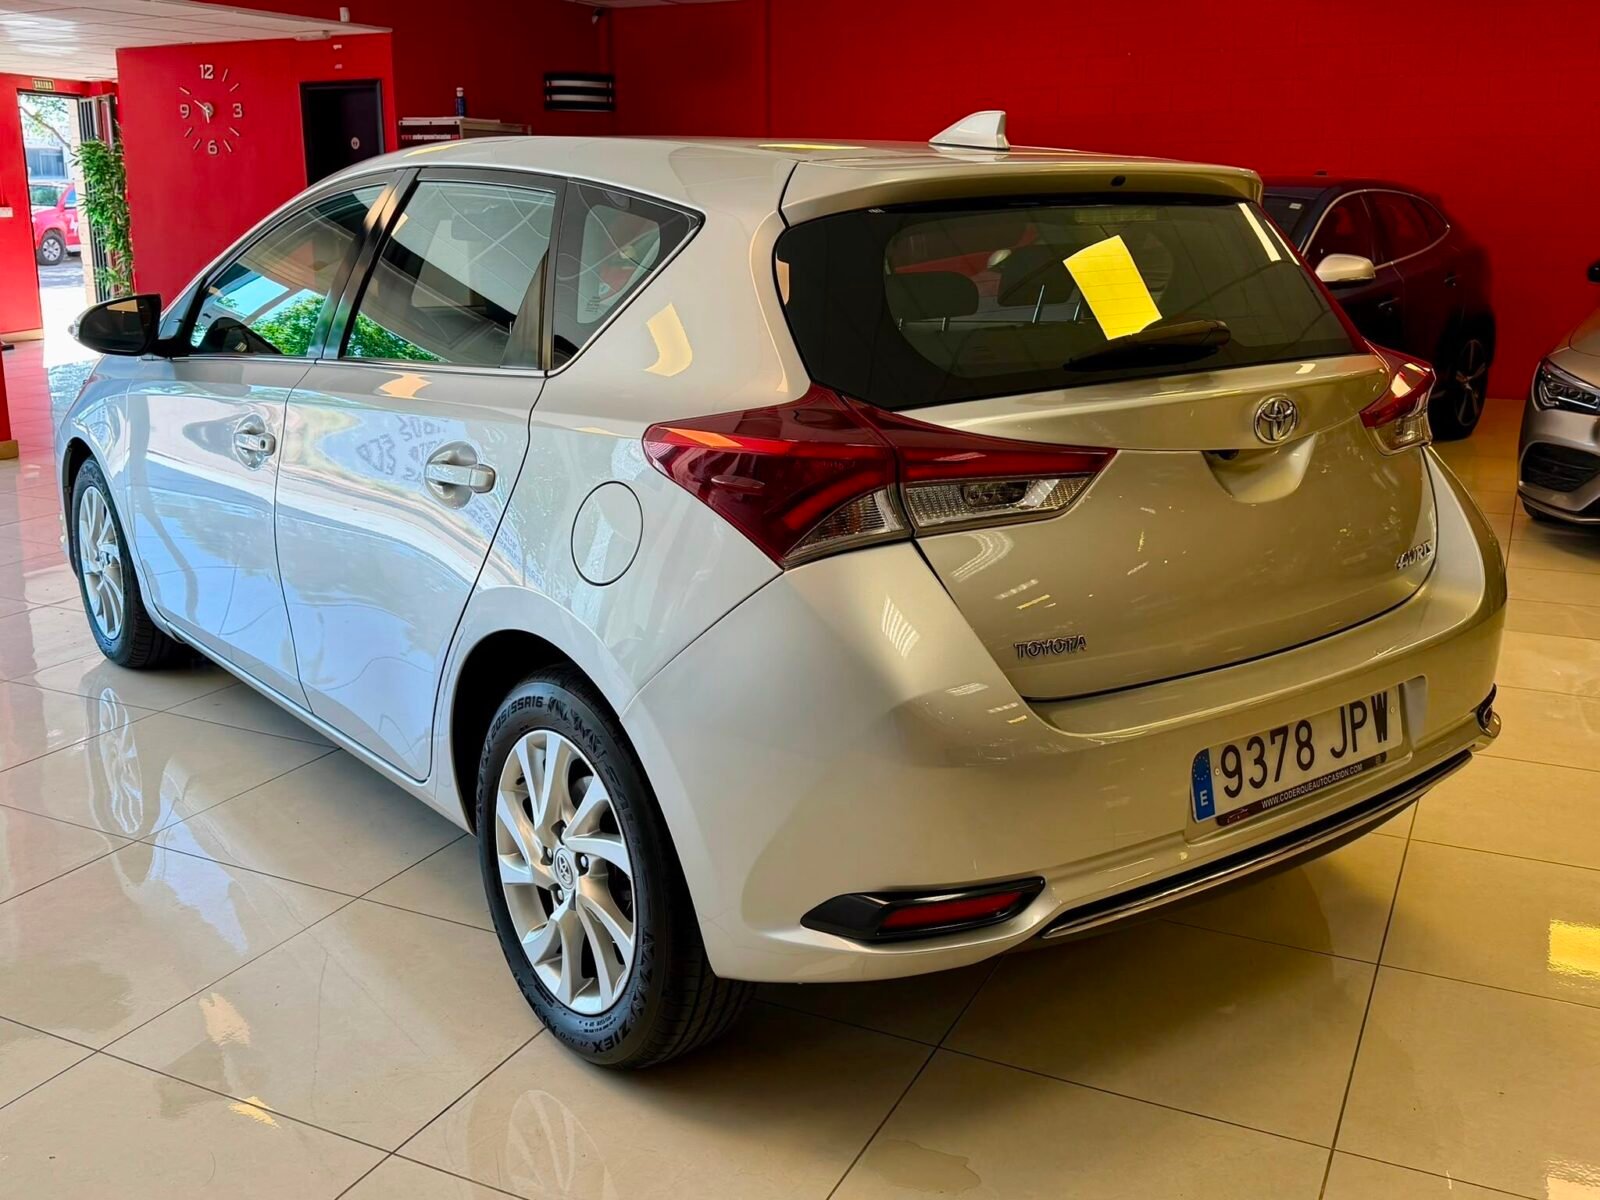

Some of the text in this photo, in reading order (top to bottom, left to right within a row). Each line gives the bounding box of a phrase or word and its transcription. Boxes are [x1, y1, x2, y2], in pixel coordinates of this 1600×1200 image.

[199, 64, 214, 80] 12
[179, 103, 243, 119] 9 3
[207, 139, 218, 155] 6
[1014, 634, 1087, 659] TOYOTA
[1220, 691, 1388, 799] 9378 JPW
[1261, 763, 1364, 809] WWW.CODERQUEAUTOCASION.COM
[1199, 789, 1209, 807] E
[591, 1020, 632, 1053] ZIEX
